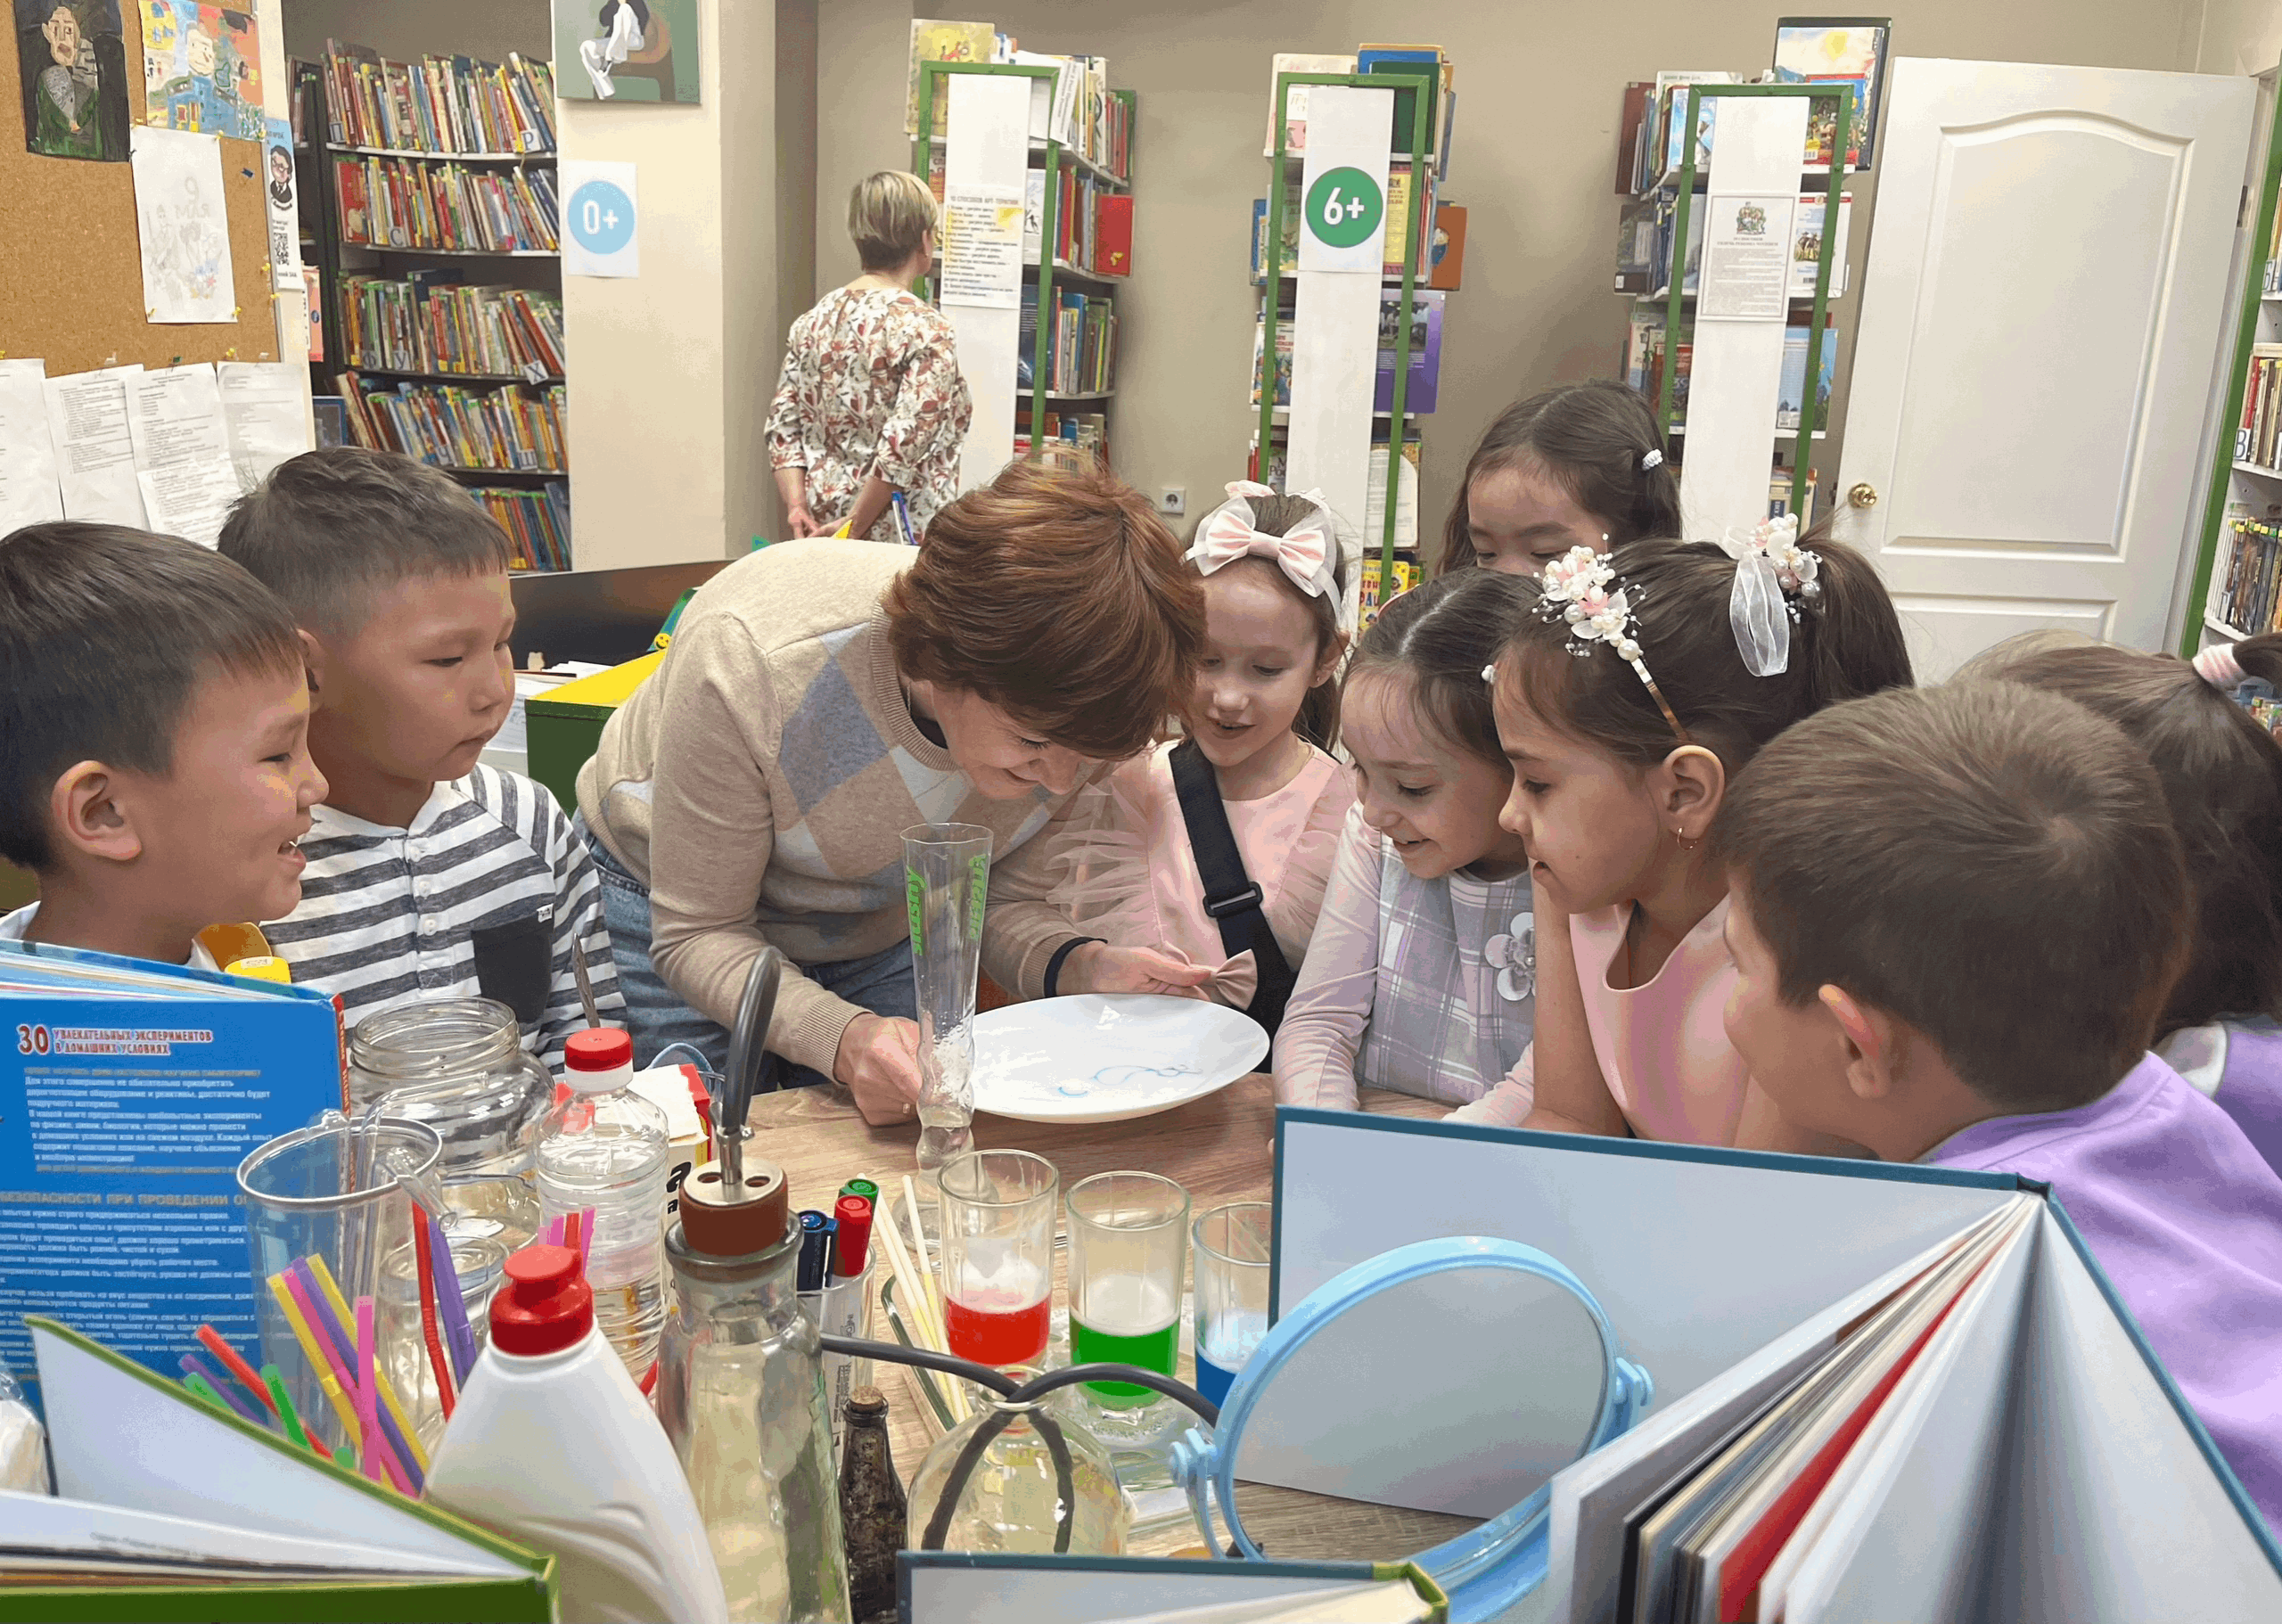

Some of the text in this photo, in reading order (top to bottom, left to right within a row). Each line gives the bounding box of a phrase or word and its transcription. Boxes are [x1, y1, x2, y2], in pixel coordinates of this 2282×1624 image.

[522, 131, 534, 151] Р
[184, 176, 199, 204] 9
[582, 199, 619, 235] 0+
[1323, 187, 1365, 226] 6+
[390, 227, 404, 247] С
[528, 362, 546, 382] Х
[2234, 430, 2247, 458] В
[18, 1025, 50, 1054] 30
[53, 1029, 212, 1042] УВЛЕКАТЕЛЬНЫХ ЭКСПЕРИМЕНТОВ
[55, 1043, 169, 1054] В ДОМАШНИХ УСЛОВИЯХ
